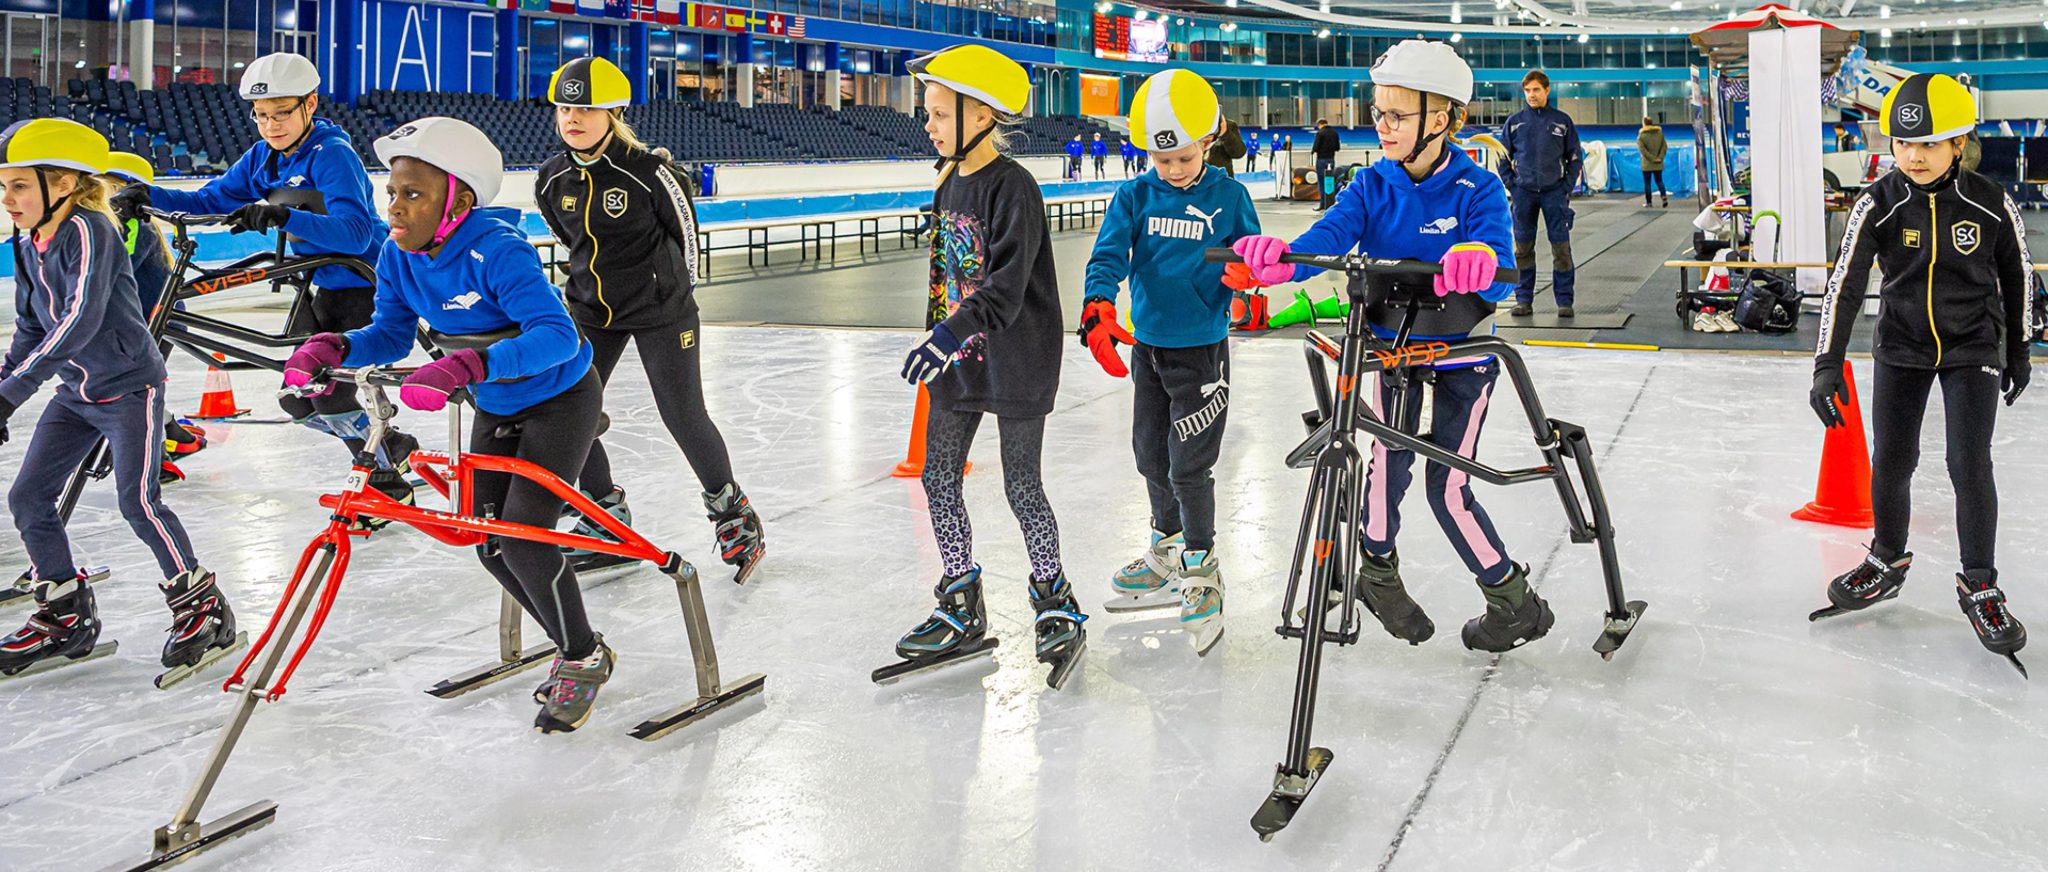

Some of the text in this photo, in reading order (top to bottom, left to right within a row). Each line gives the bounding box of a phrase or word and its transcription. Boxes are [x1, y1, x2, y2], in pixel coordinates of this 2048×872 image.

[564, 82, 580, 93] SK
[1902, 107, 1918, 120] SK
[1157, 132, 1175, 145] SK
[607, 193, 623, 207] SK
[1148, 216, 1204, 241] PUMA
[1956, 227, 1976, 243] SK
[192, 268, 267, 295] WISP
[1373, 341, 1450, 369] WISP
[1174, 388, 1229, 442] PUMA
[347, 476, 361, 488] 07
